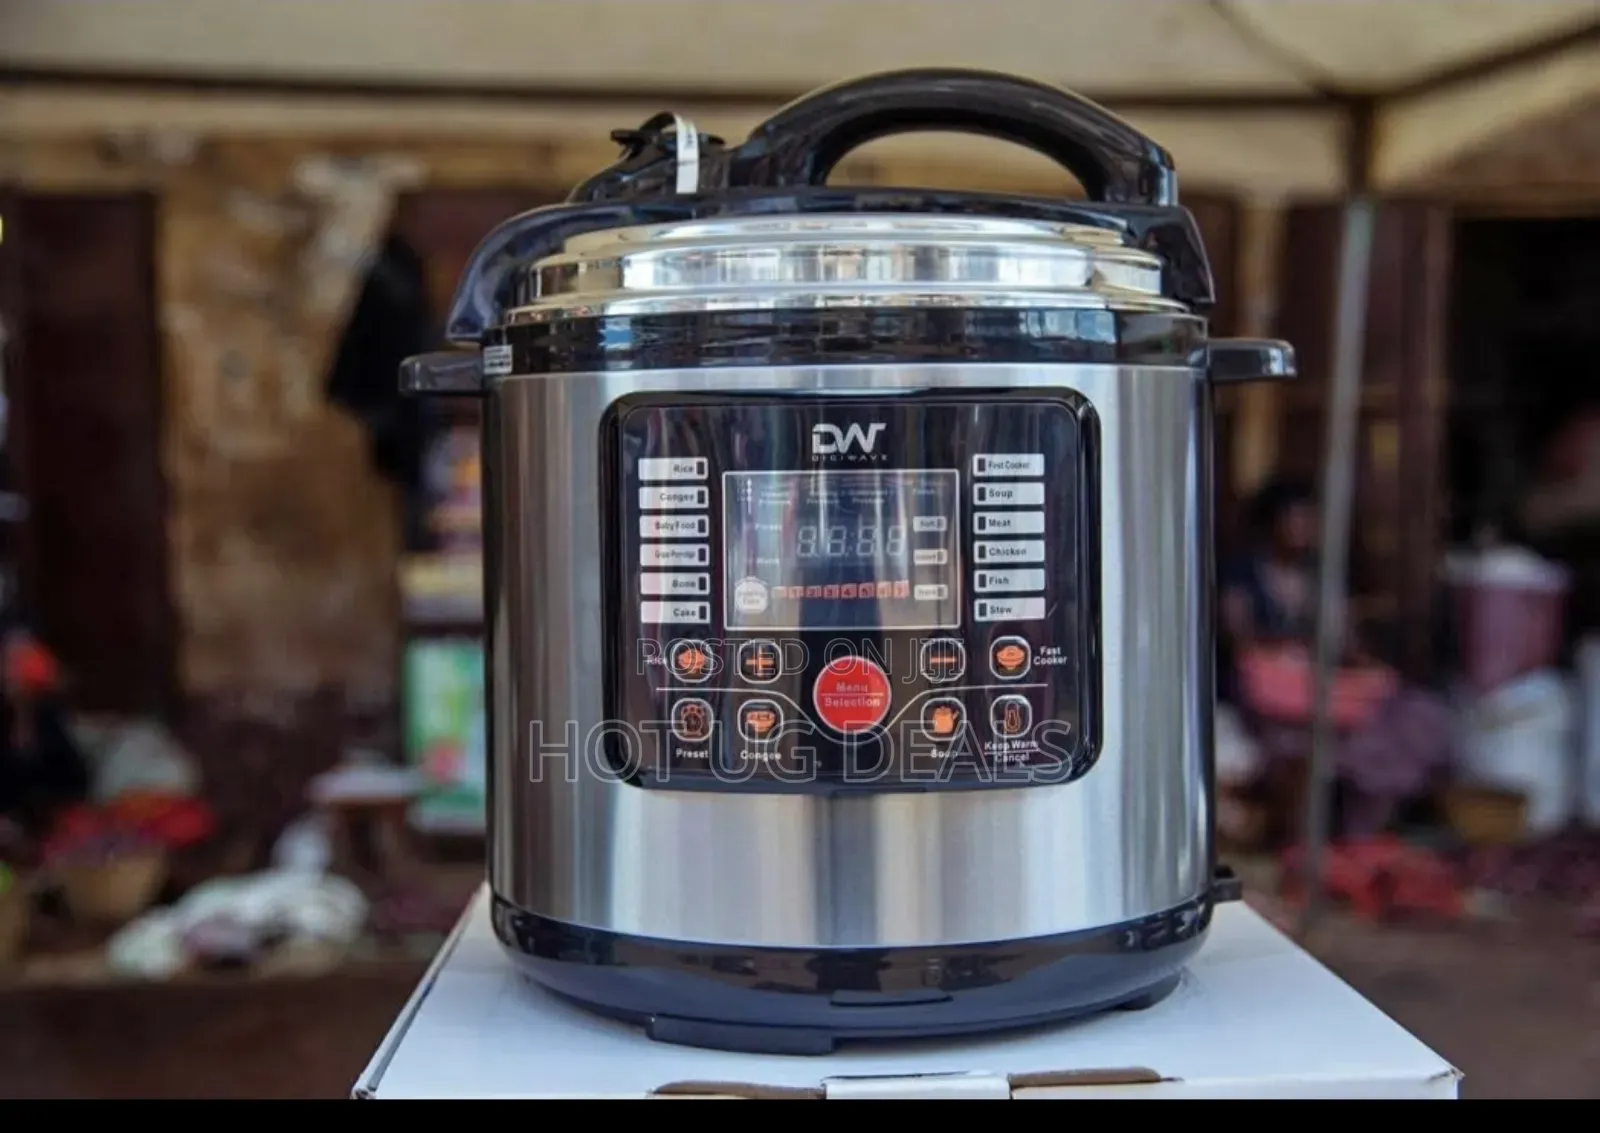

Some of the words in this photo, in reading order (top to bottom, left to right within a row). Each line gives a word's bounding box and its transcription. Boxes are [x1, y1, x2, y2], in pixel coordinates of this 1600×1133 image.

[673, 463, 694, 473] Rice
[660, 493, 694, 503] Congee
[988, 488, 1013, 500] Soup
[654, 521, 674, 531] Baby
[675, 521, 696, 530] Food
[988, 518, 1011, 527] Meat
[988, 547, 1027, 557] Chicken
[672, 579, 696, 589] Bone
[988, 576, 1010, 585] Fish
[673, 608, 697, 618] Cake
[989, 605, 1013, 614] Stew
[1040, 646, 1061, 656] Fast
[1033, 655, 1067, 666] Cooker
[836, 682, 868, 693] Menu
[824, 696, 881, 708] Selection
[984, 740, 1010, 754] Keep
[1011, 740, 1038, 749] Warm
[676, 748, 709, 759] Preset
[740, 750, 782, 762] Congee
[930, 749, 958, 760] Soup
[995, 751, 1029, 763] Cancel
